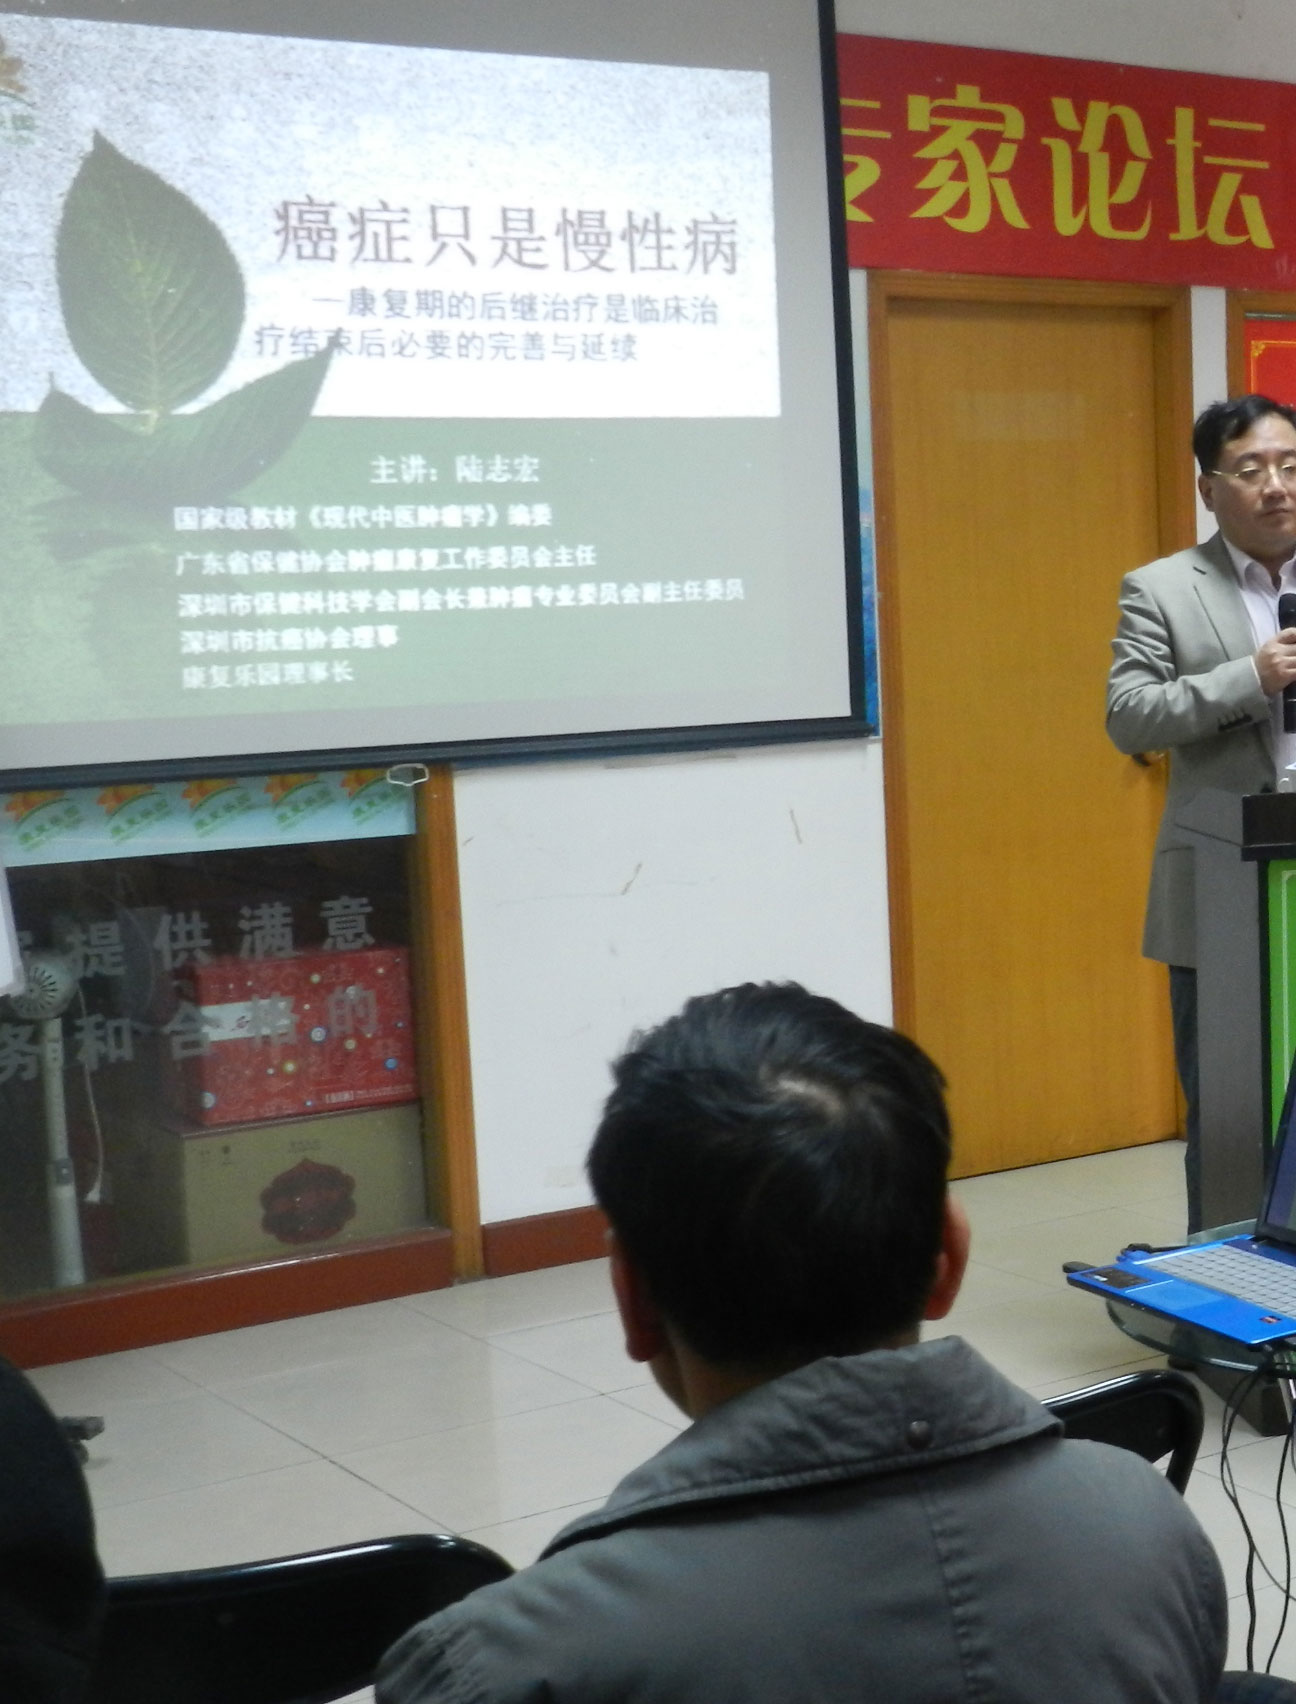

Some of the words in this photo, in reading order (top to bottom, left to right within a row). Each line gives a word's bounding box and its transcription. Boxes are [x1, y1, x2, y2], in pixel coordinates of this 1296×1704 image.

[273, 194, 738, 275] 癌症只是慢性病
[254, 323, 638, 362] 疗结束后必要的完善与延续
[17, 895, 374, 981] 提供满意
